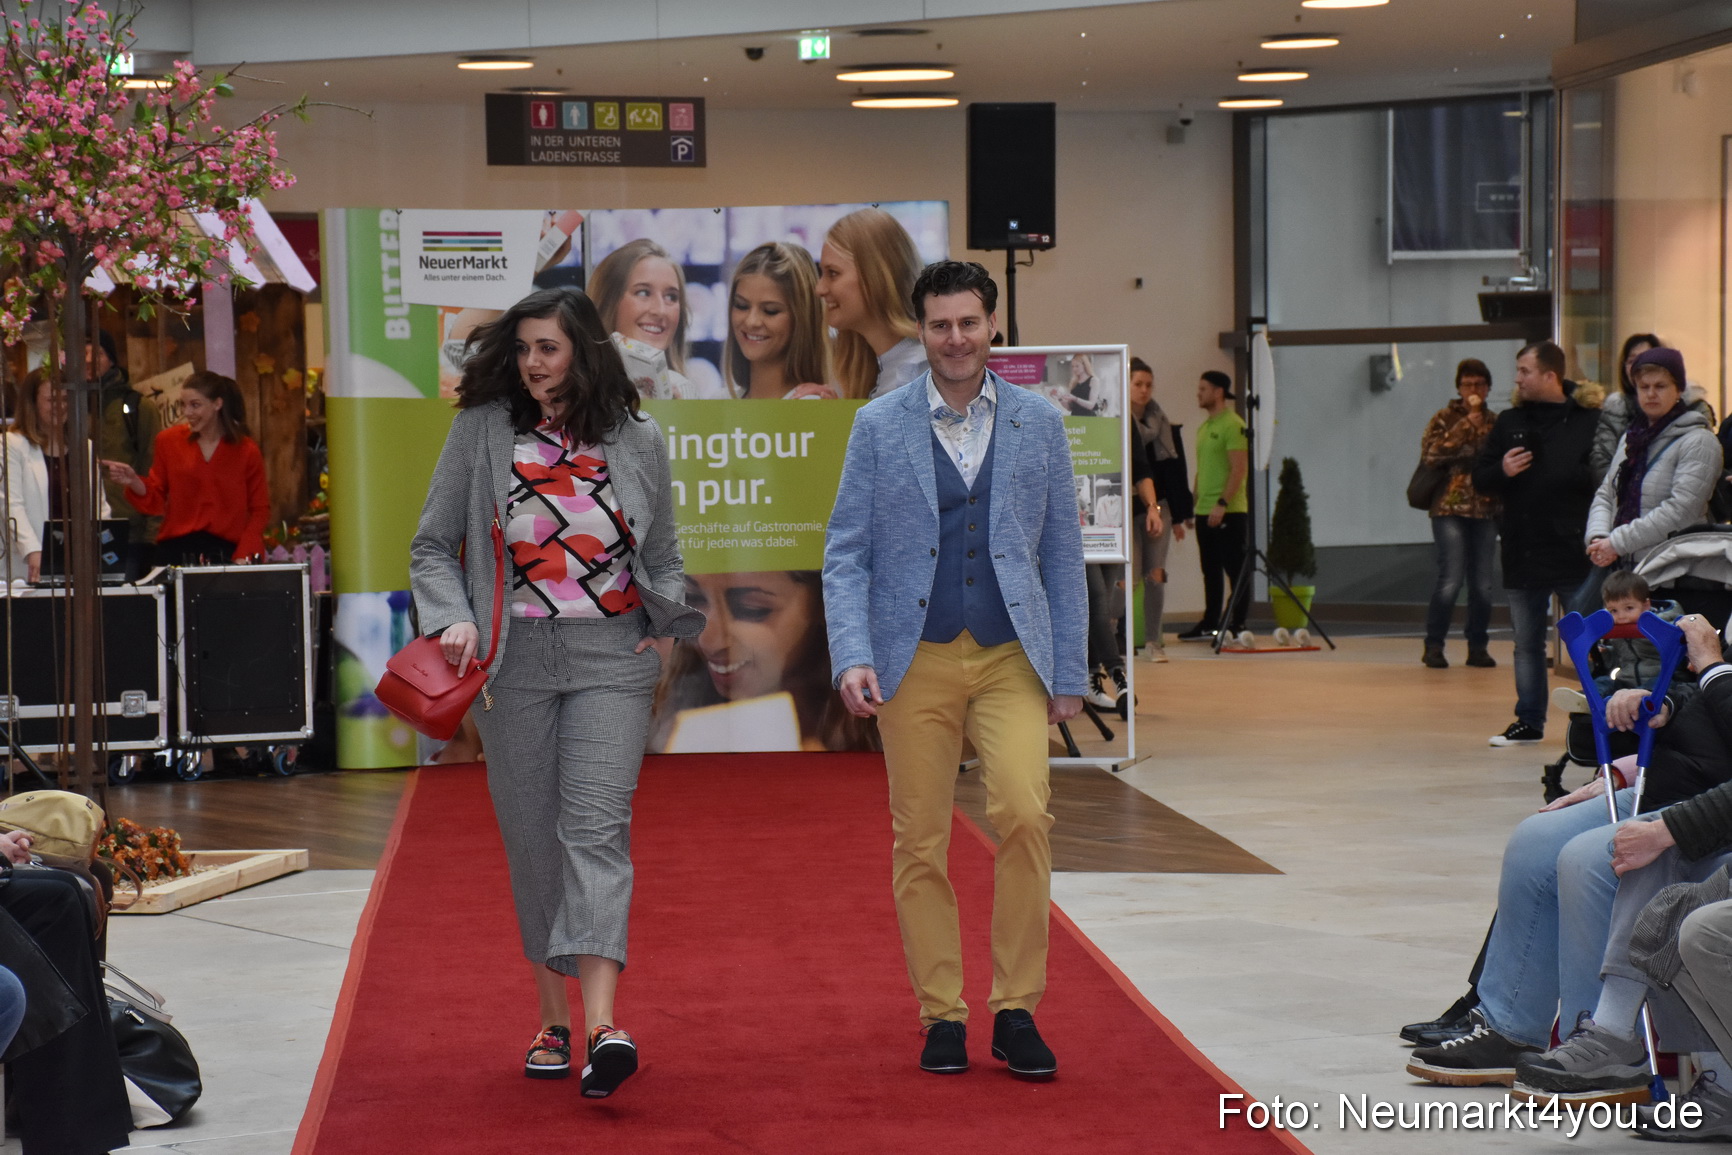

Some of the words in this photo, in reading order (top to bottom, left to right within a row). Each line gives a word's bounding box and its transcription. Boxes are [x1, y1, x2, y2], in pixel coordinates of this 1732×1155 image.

[531, 136, 541, 147] IN
[545, 136, 564, 147] DER
[569, 136, 621, 147] UNTEREN
[531, 151, 621, 163] LADENSTRASSE
[677, 144, 689, 161] P
[1041, 234, 1050, 243] 12
[419, 255, 508, 269] NeuerMarkt
[486, 273, 506, 281] Dach.
[1064, 426, 1086, 435] steil
[668, 426, 815, 468] ingtour
[698, 478, 772, 514] pur.
[674, 522, 730, 534] Geschäfte
[732, 521, 751, 533] auf
[753, 520, 826, 533] Gastronomie,
[688, 537, 704, 549] für
[707, 537, 738, 551] jeden
[741, 539, 763, 548] was
[765, 536, 798, 548] dabei.
